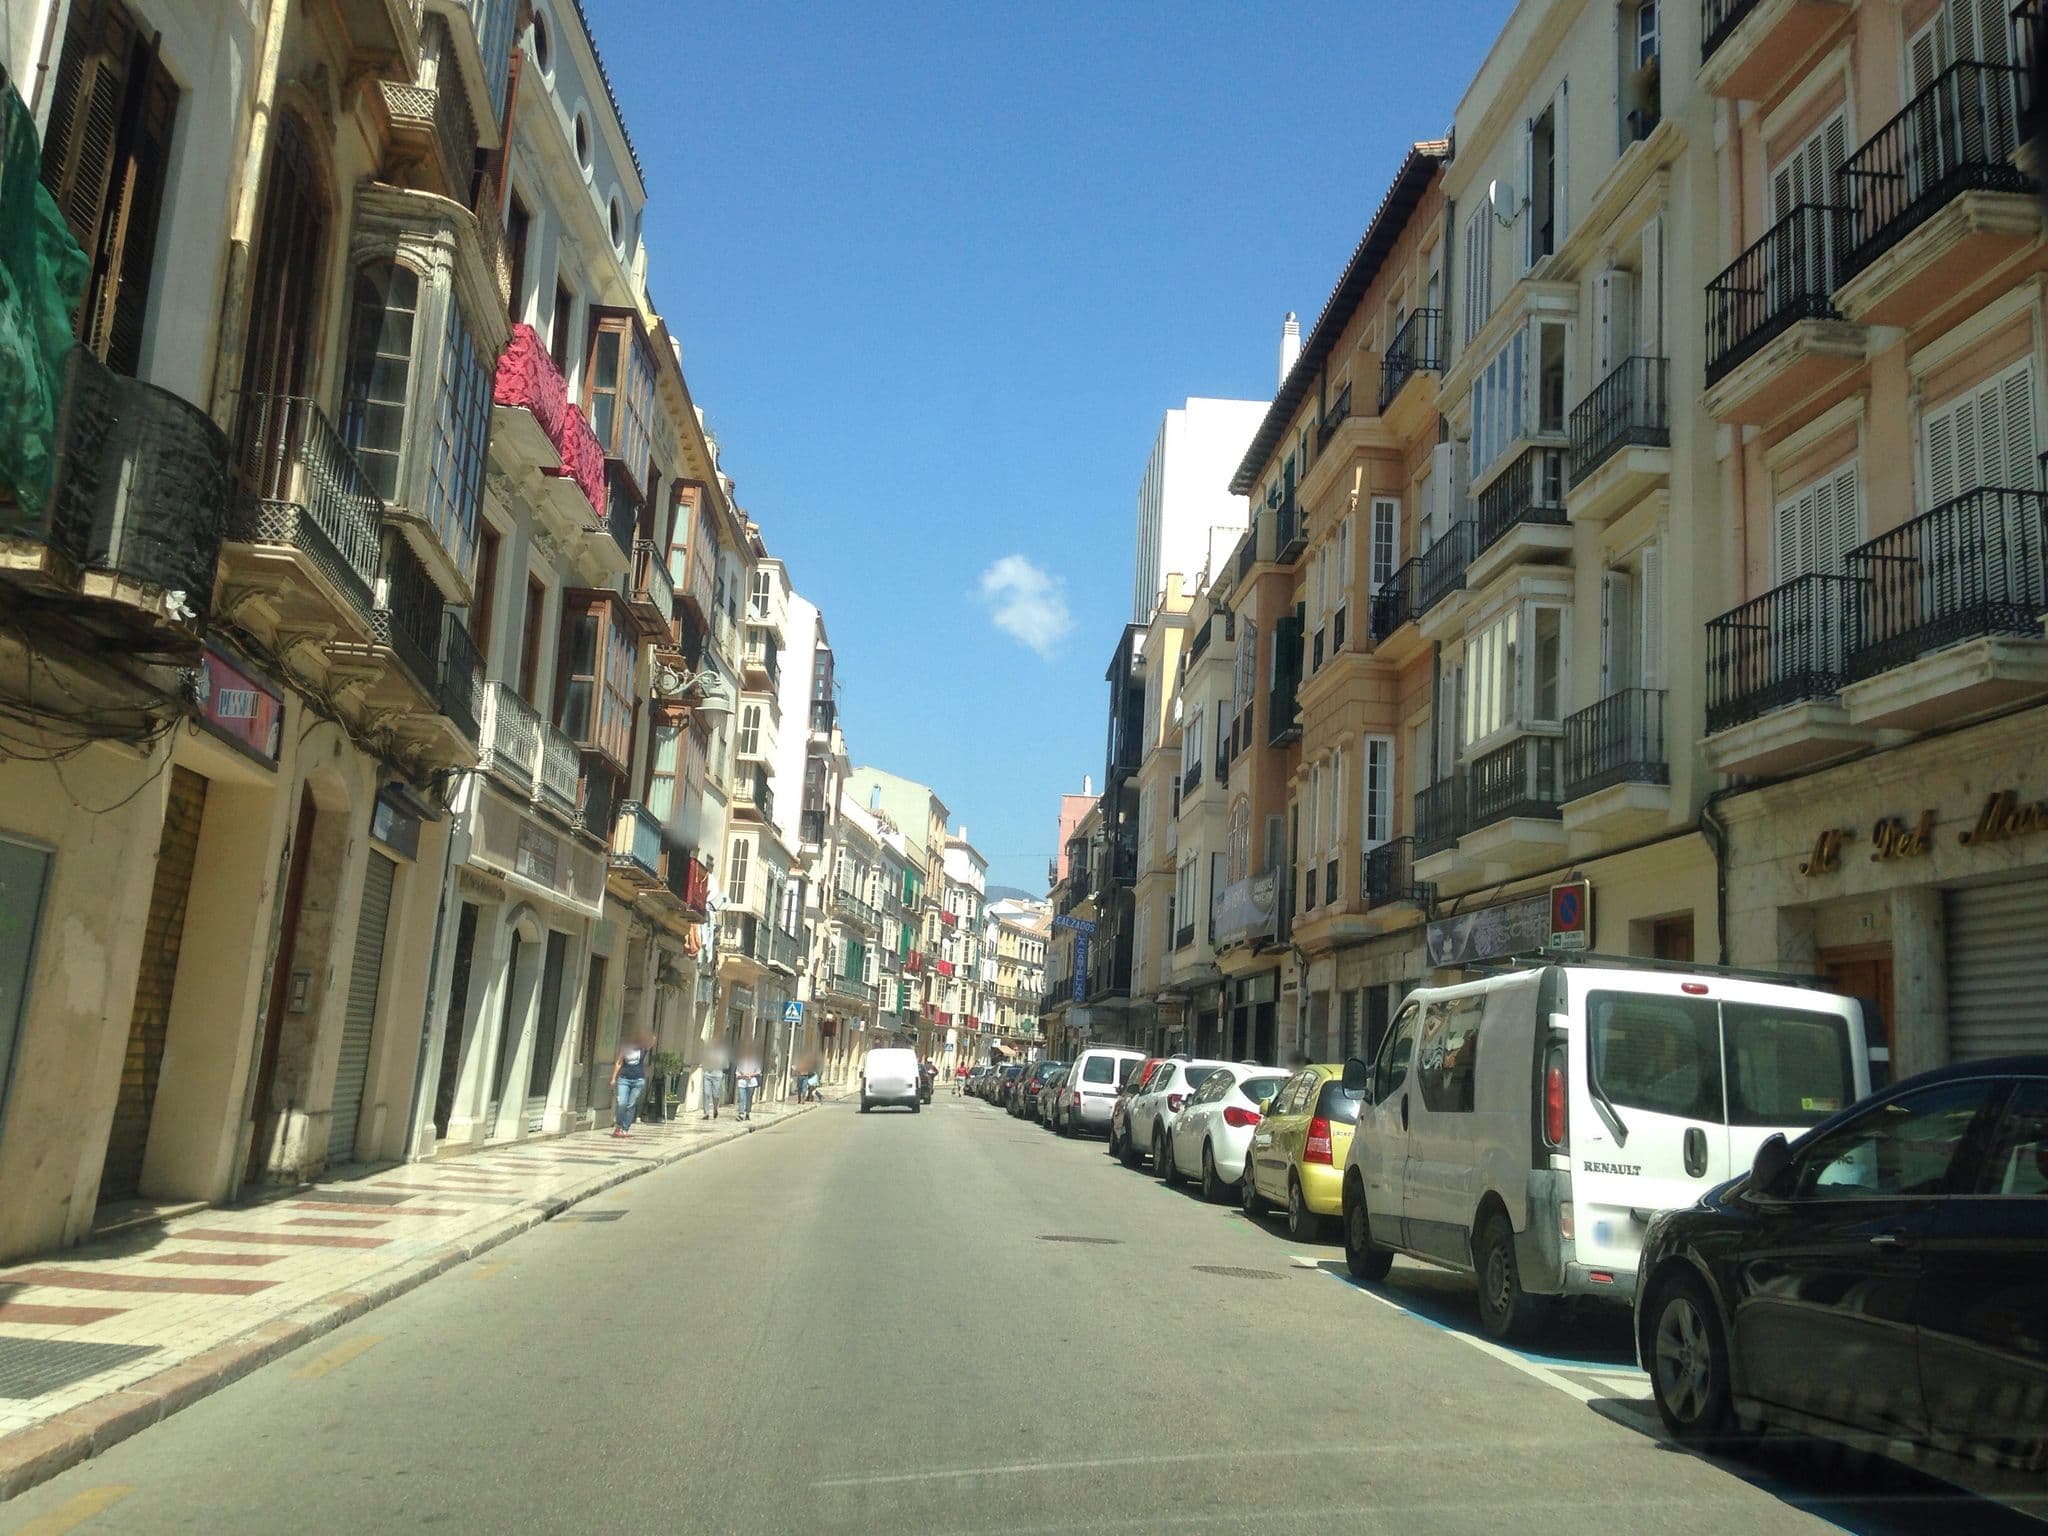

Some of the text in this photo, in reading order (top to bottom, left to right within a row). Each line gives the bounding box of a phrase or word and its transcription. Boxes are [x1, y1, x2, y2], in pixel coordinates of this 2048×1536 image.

[1870, 808, 1937, 863] Del
[1056, 916, 1096, 933] CALZADOS
[1584, 1161, 1641, 1176] RENAULT
